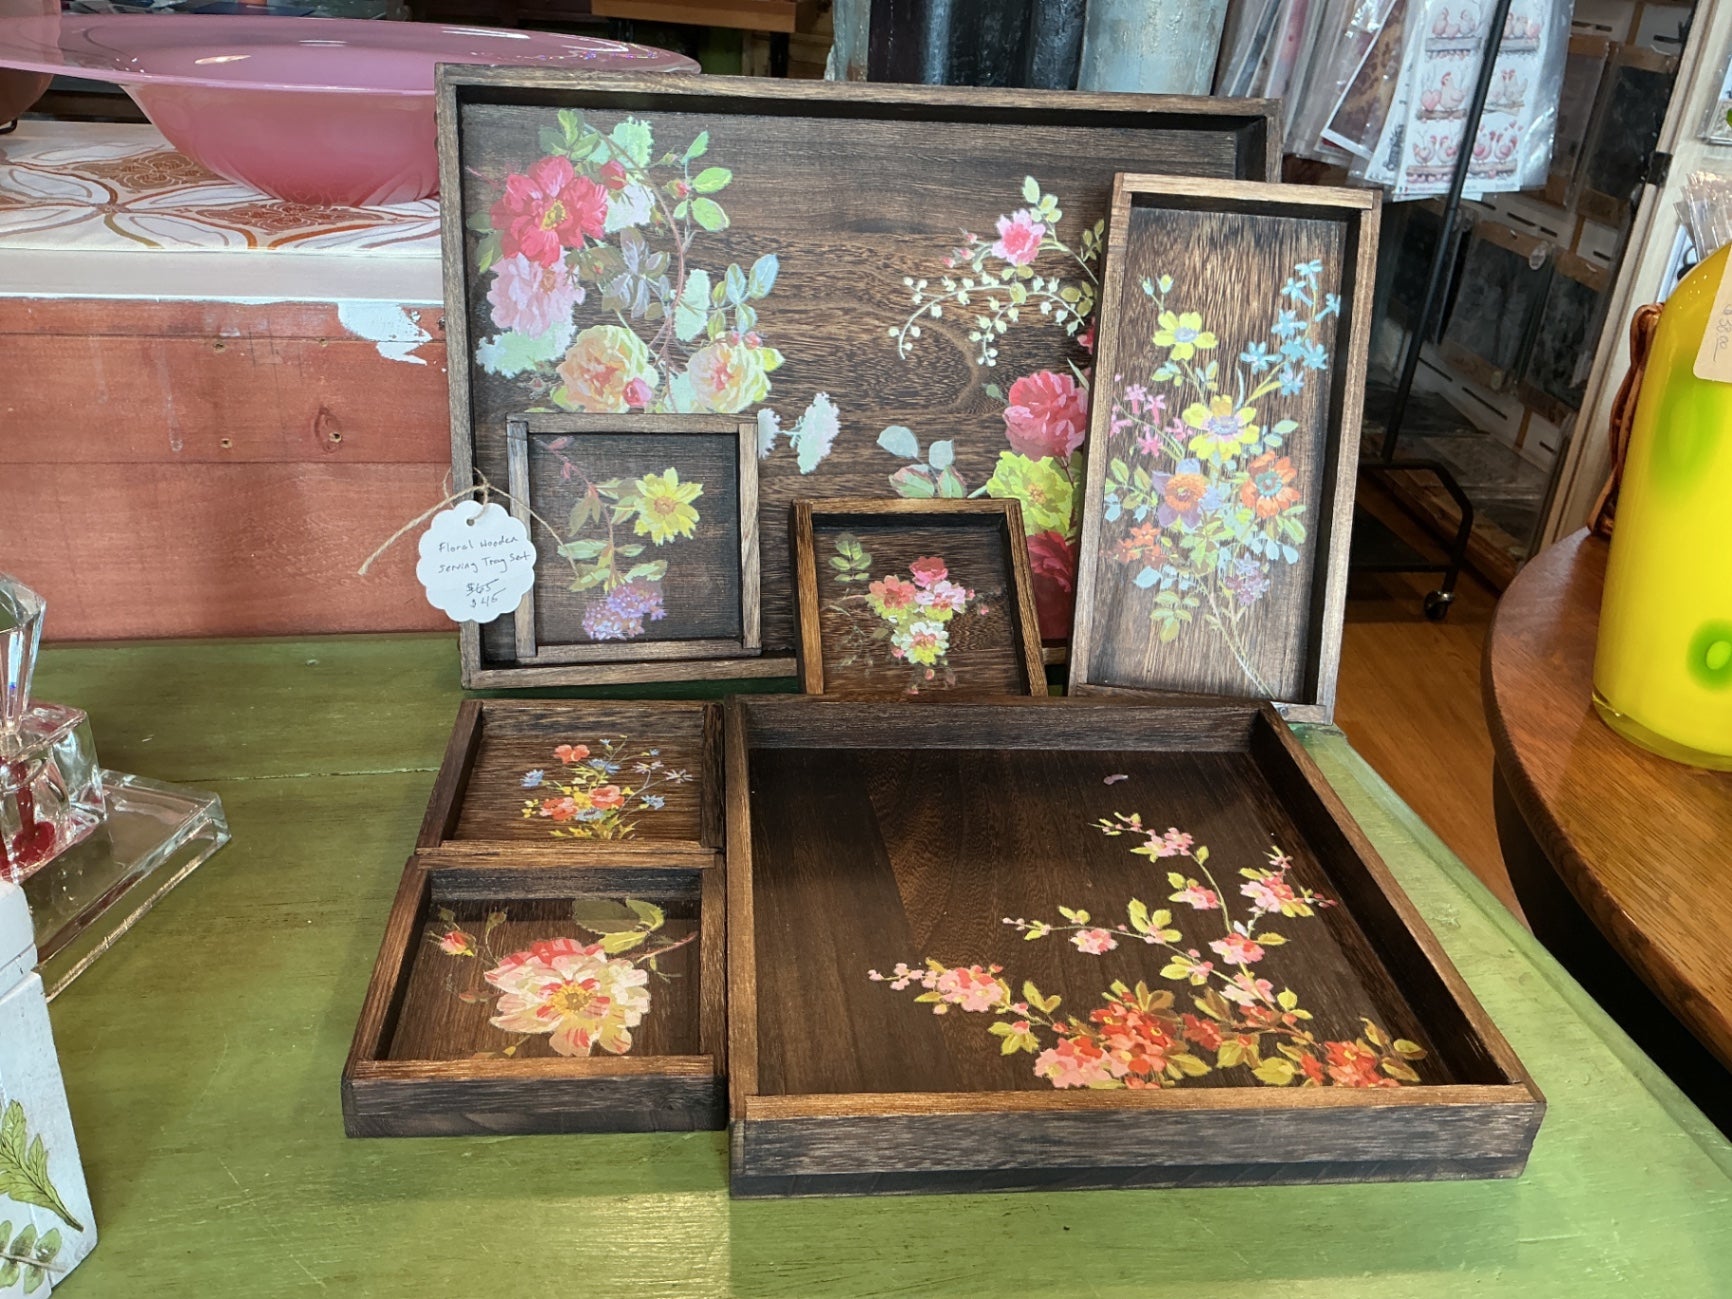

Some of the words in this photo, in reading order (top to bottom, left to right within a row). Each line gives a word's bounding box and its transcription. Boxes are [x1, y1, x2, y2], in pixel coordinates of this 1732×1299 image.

[438, 539, 474, 553] Floral
[479, 535, 519, 549] Wooden
[481, 556, 508, 574] Tray
[509, 551, 531, 562] Set
